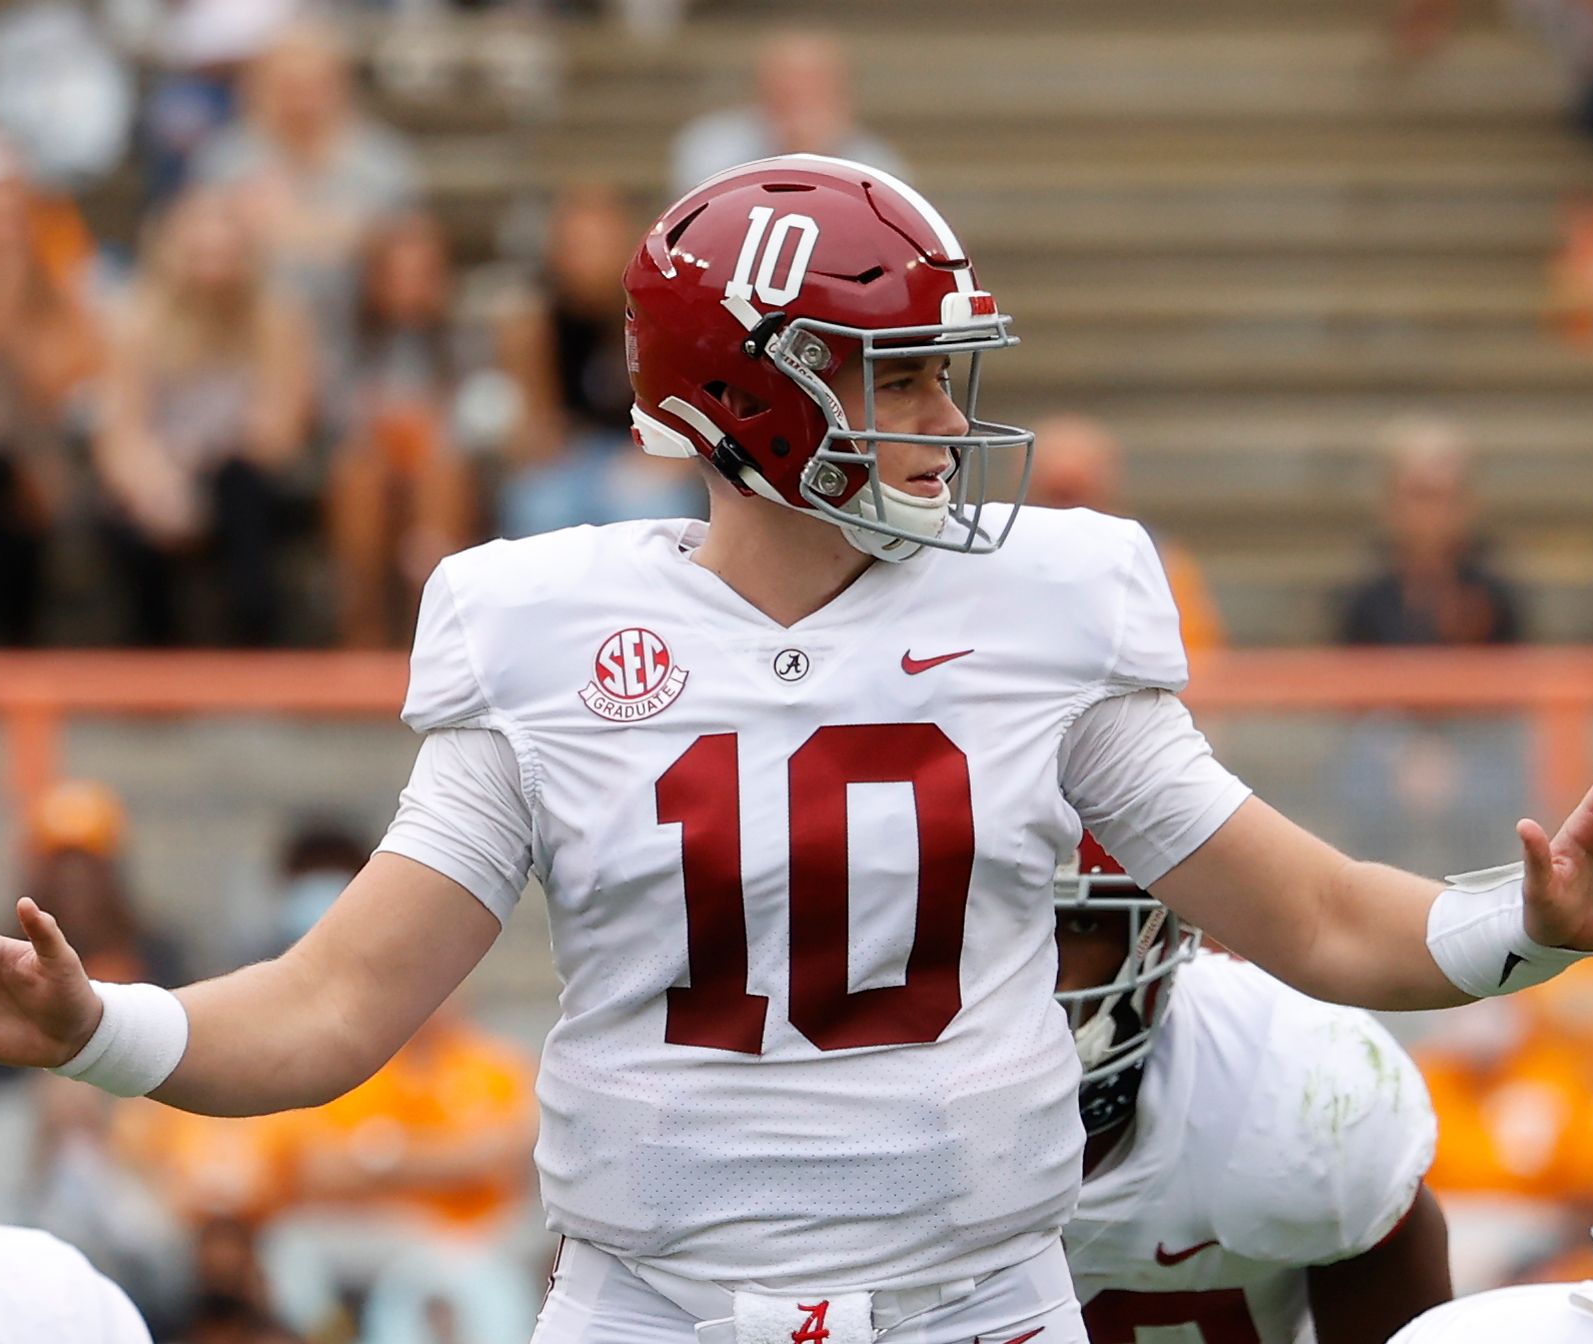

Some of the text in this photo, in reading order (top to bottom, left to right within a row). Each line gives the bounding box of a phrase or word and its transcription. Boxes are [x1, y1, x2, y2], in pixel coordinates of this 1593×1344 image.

[724, 206, 819, 306] 10
[592, 686, 677, 719] GRADUATE
[599, 629, 669, 697] SEC
[655, 723, 976, 1056] 10
